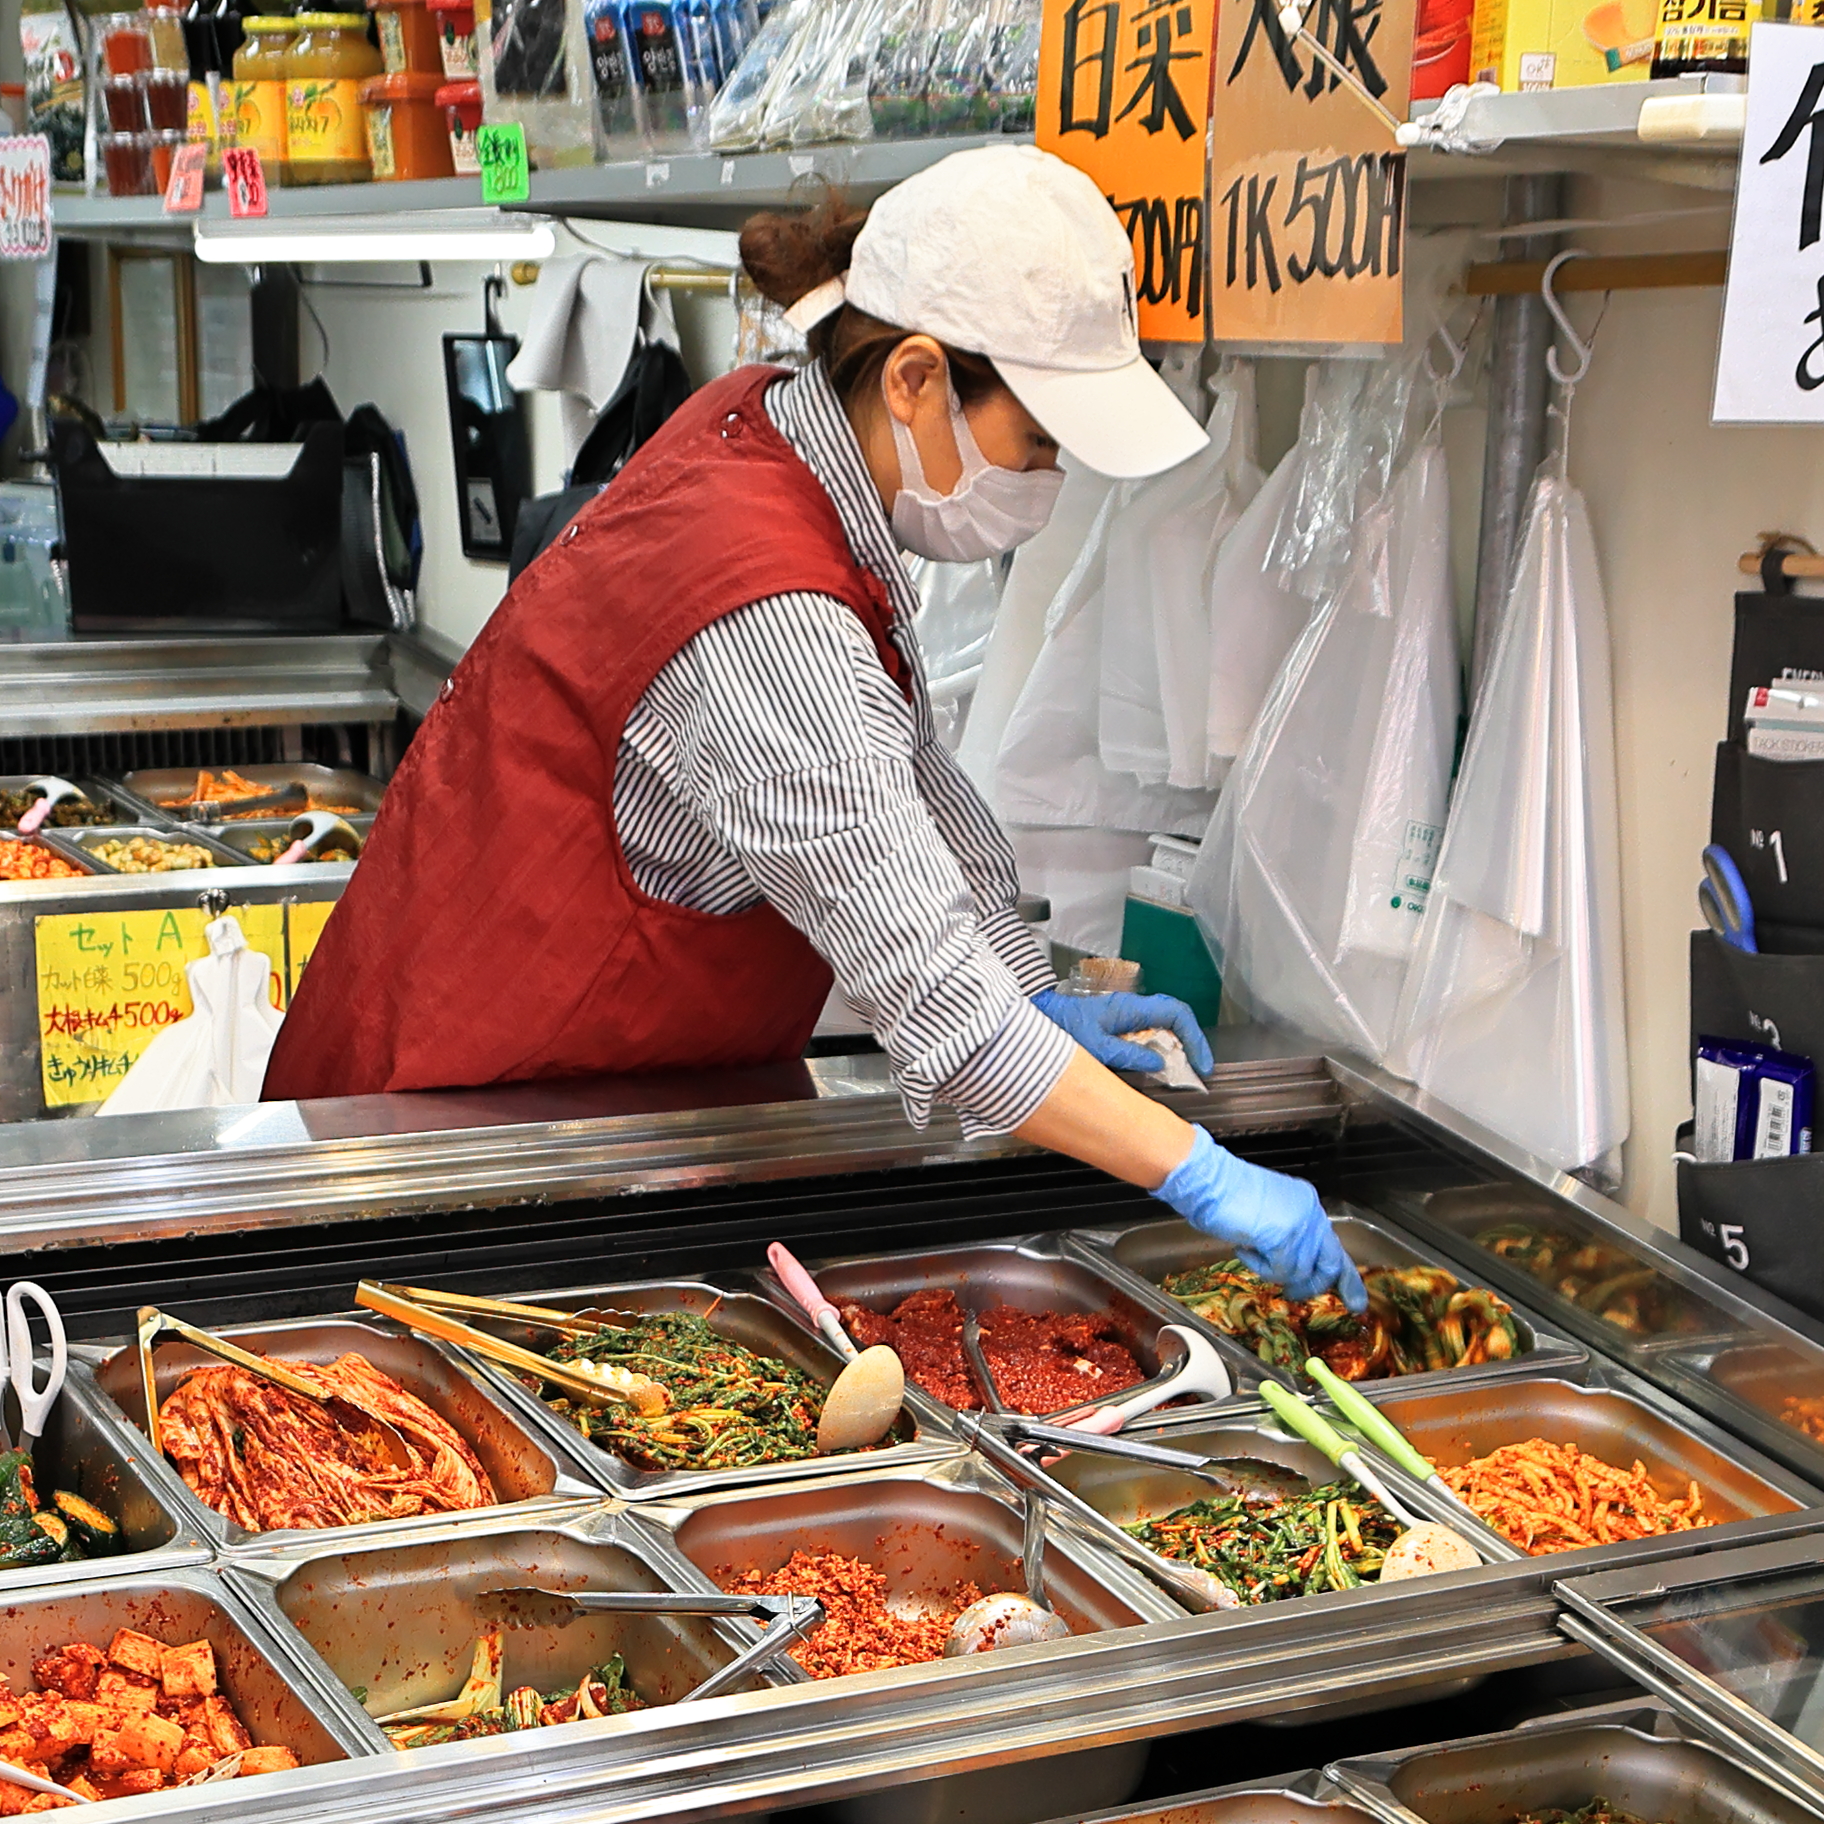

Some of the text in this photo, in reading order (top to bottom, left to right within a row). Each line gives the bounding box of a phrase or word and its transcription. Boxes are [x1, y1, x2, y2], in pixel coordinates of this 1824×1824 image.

[1769, 830, 1788, 884] 1
[69, 910, 184, 957] セット A
[1719, 1223, 1750, 1271] 5
